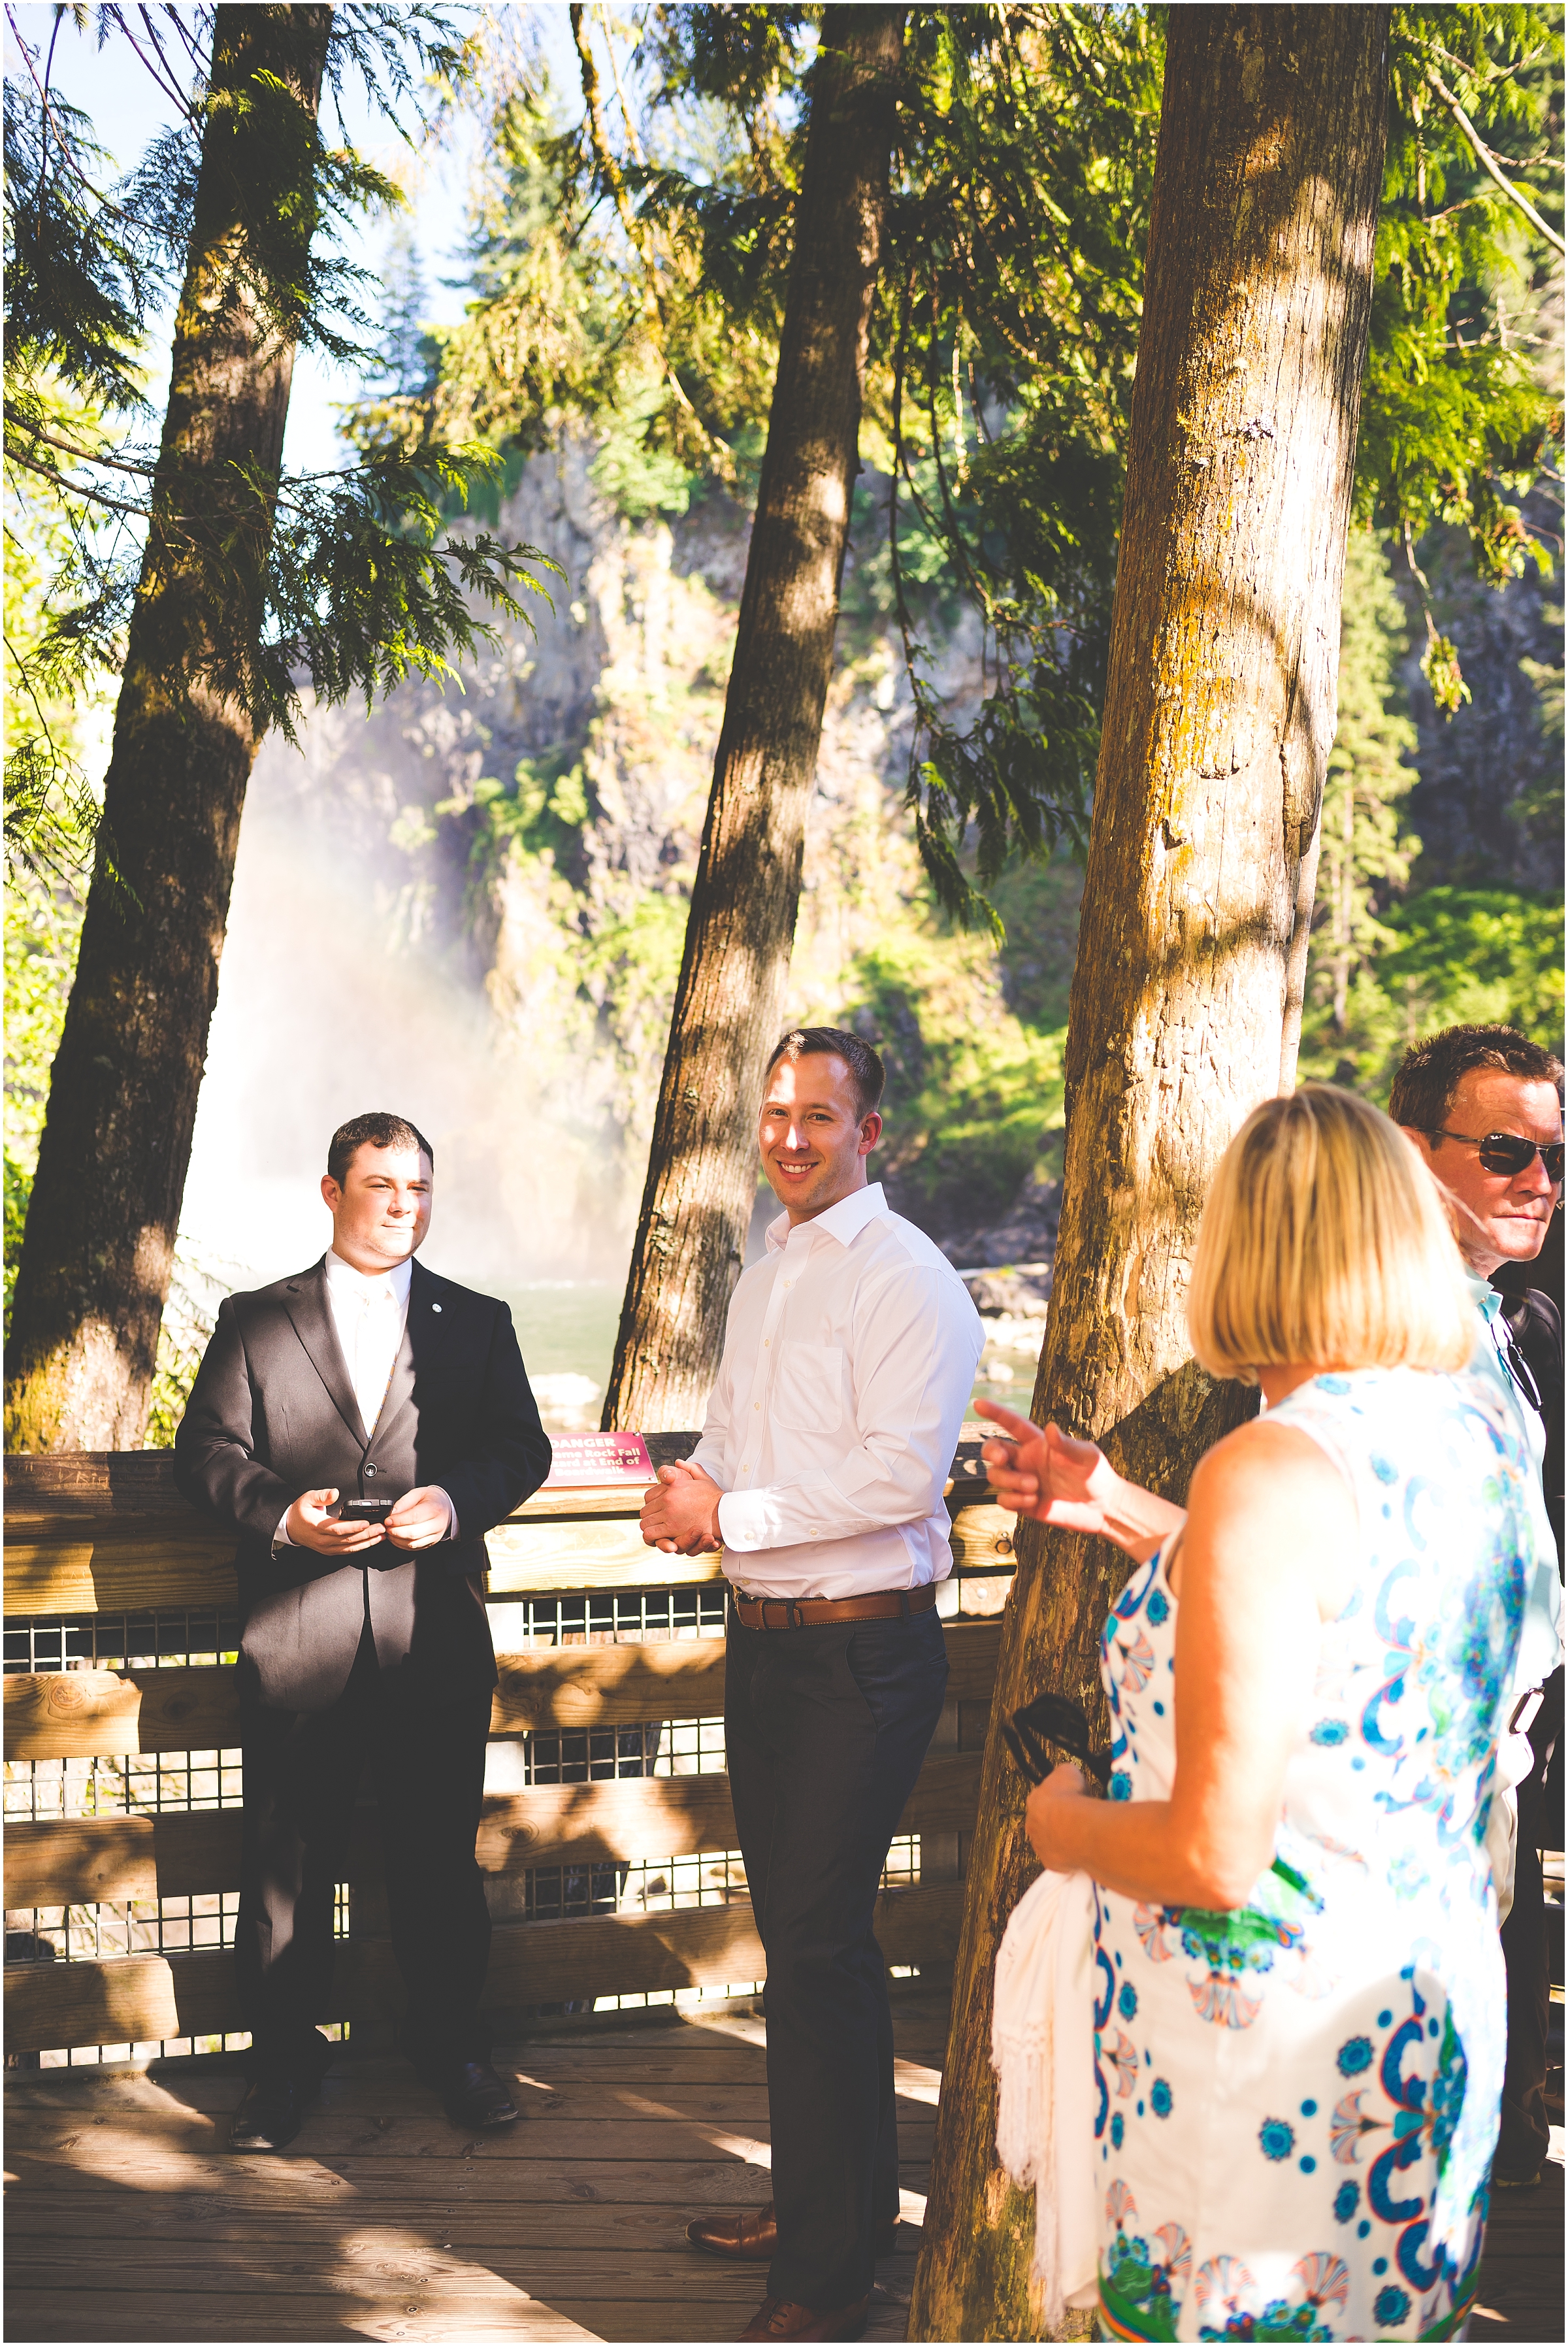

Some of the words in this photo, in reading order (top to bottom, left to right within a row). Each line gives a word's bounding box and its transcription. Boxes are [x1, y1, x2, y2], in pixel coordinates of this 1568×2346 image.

[585, 1449, 615, 1457] Rock
[598, 1457, 623, 1466] End
[626, 1456, 640, 1465] of
[555, 1467, 625, 1476] Boardwalk
